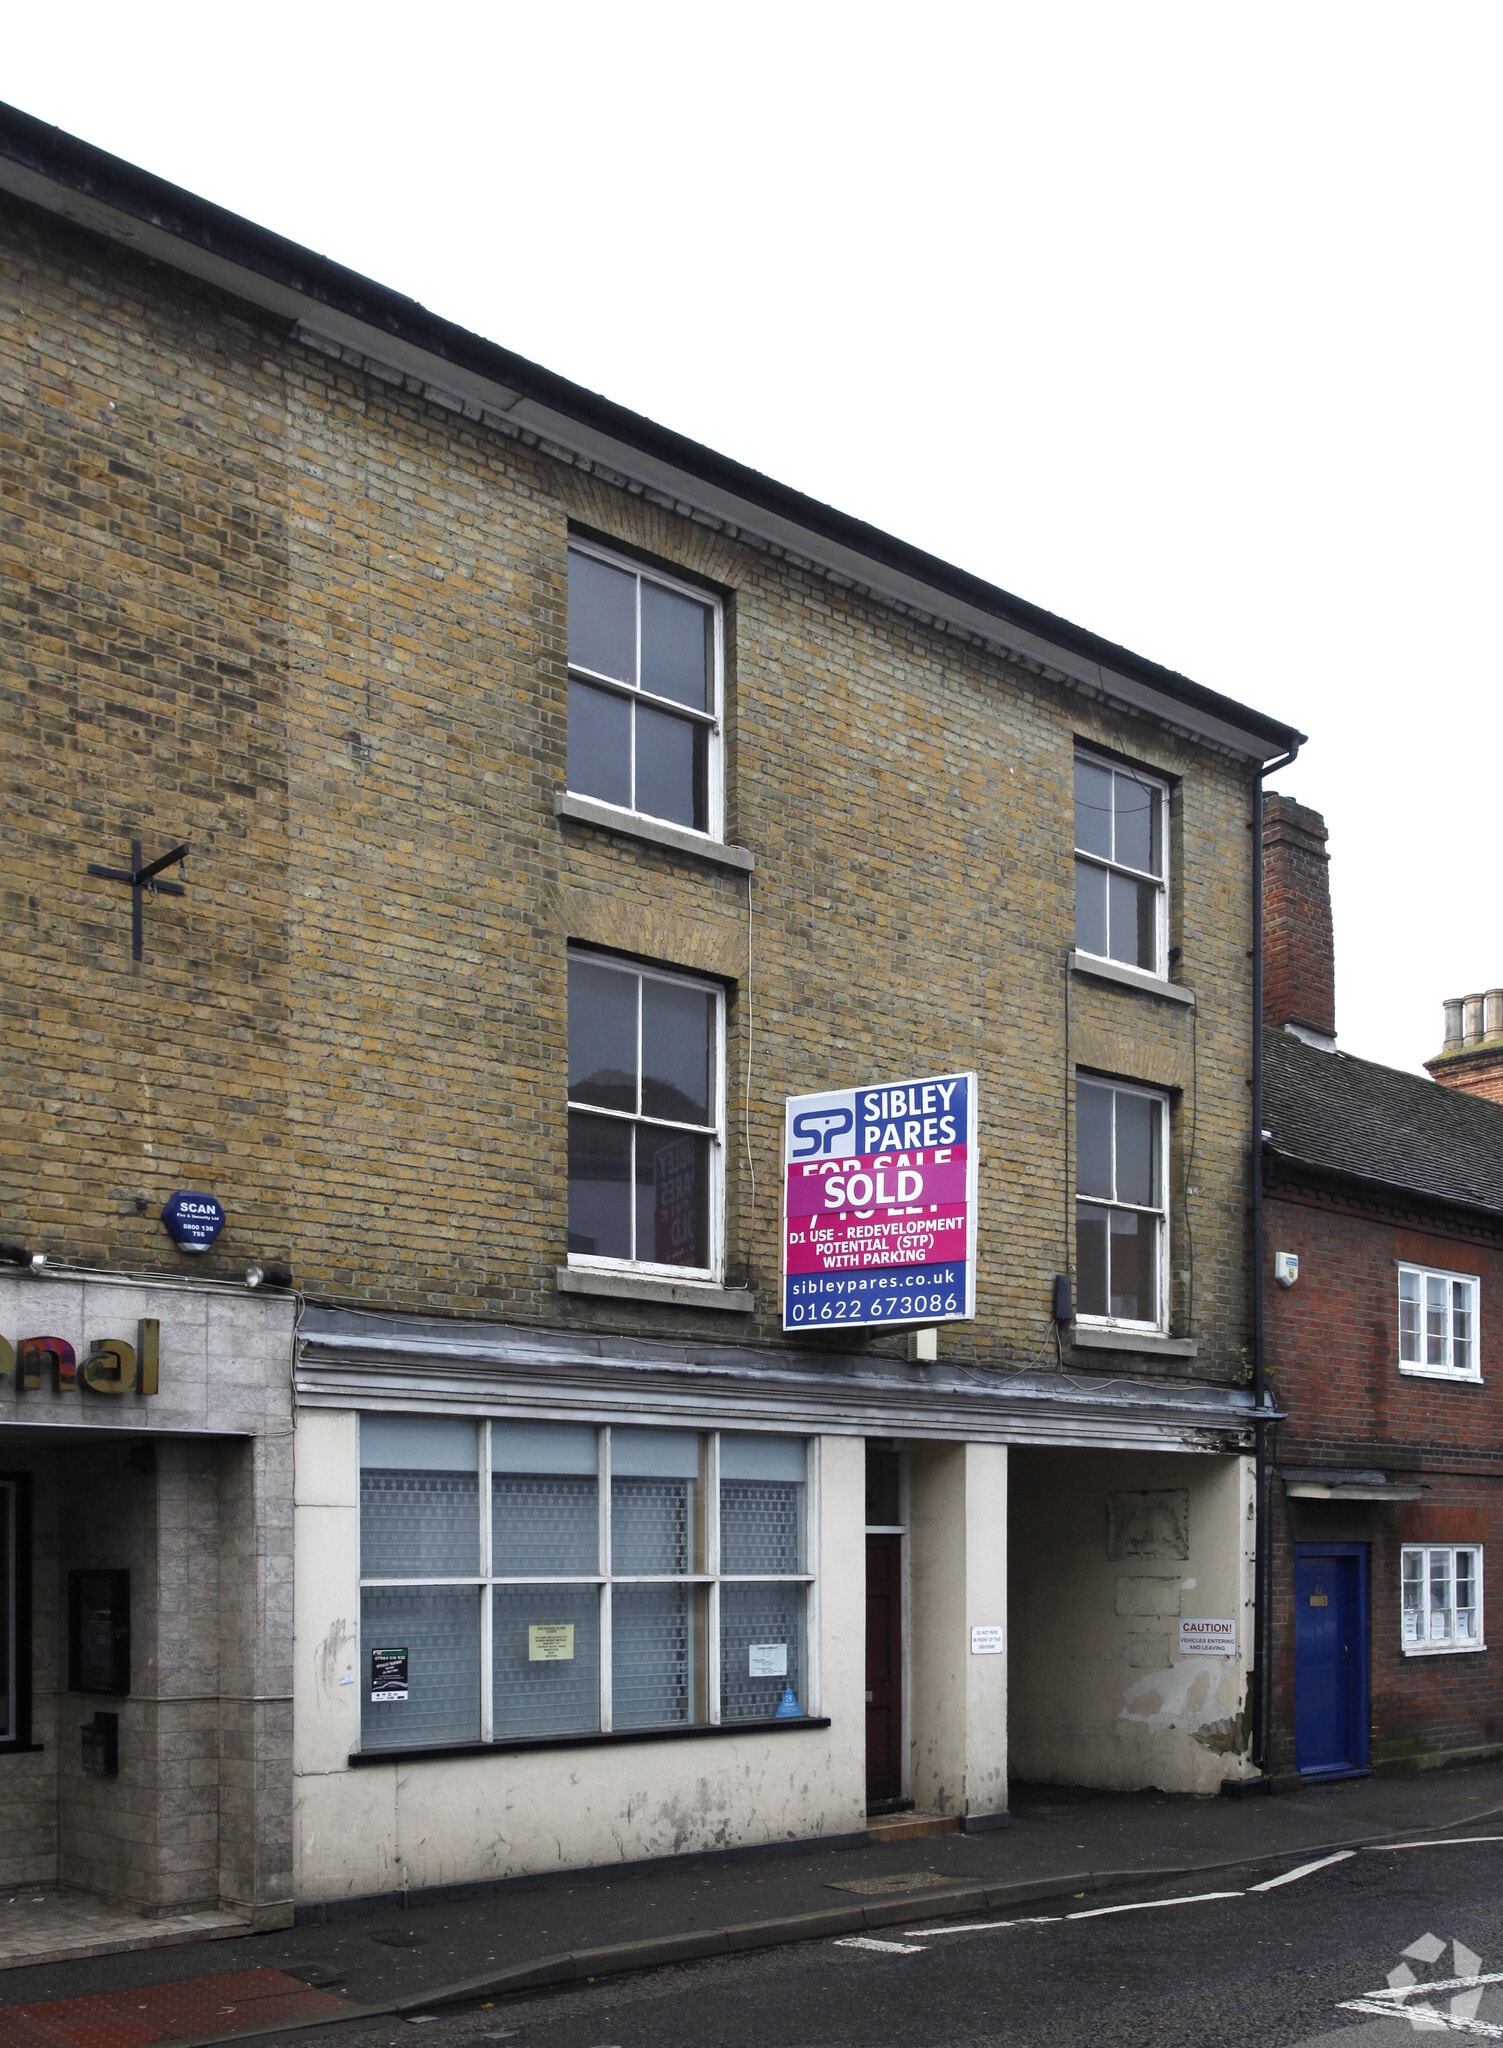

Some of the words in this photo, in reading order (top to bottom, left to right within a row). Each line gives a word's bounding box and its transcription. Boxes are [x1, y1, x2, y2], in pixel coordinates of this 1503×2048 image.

[864, 1082, 957, 1122] SIBLEY
[865, 1115, 957, 1154] PARES
[824, 1170, 923, 1208] SOLD
[180, 1202, 216, 1215] SCAN
[183, 1223, 200, 1231] 0800
[789, 1232, 806, 1244] D1
[810, 1229, 834, 1242] USE
[847, 1217, 965, 1239] REDEVELOPMENT
[816, 1237, 889, 1255] POTENTIAL
[897, 1234, 934, 1251] (STP)
[823, 1254, 860, 1268] WITH
[863, 1249, 926, 1266] PARKING
[793, 1269, 955, 1295] sibleypares.co.uk
[792, 1300, 862, 1322] 01622
[870, 1293, 957, 1317] 673086
[1183, 1622, 1232, 1633] CAUTION!
